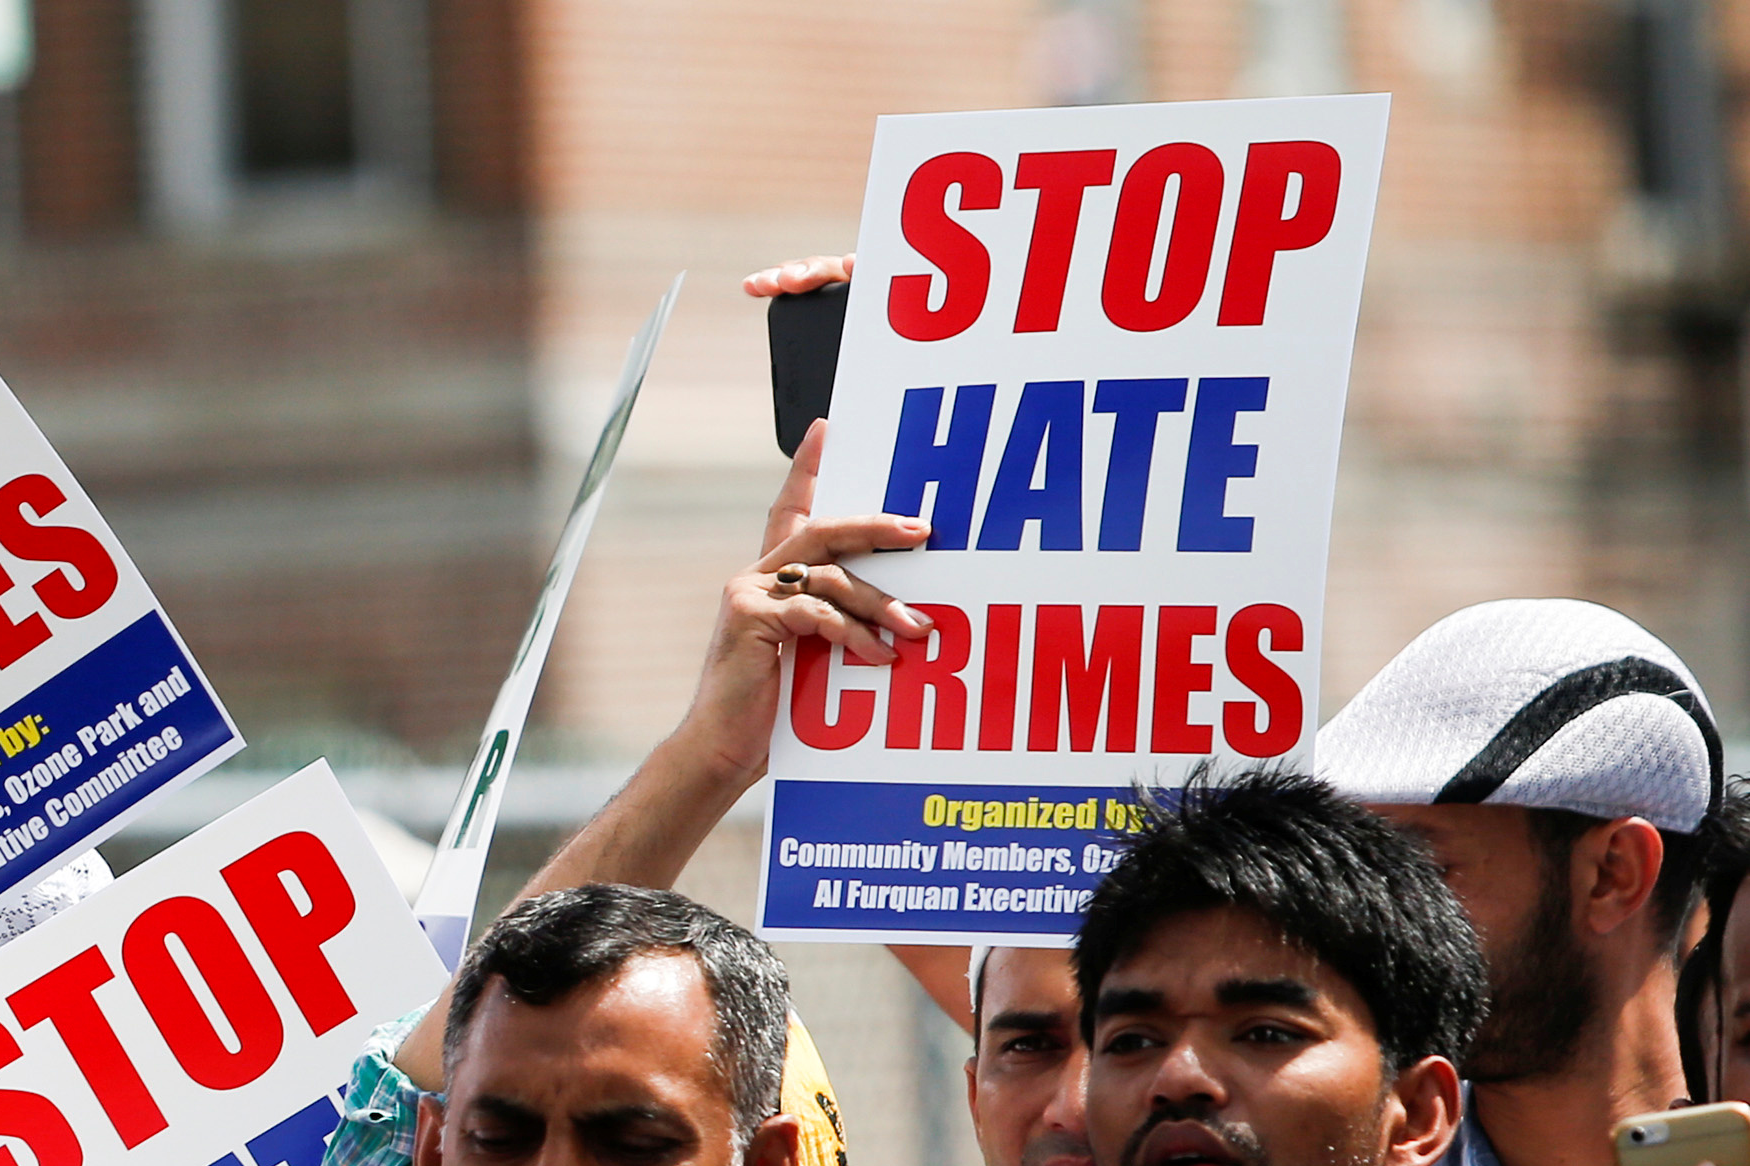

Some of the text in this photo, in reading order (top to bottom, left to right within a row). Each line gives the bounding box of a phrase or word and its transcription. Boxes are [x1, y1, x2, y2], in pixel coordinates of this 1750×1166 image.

[889, 141, 1341, 341] STOP
[873, 376, 1270, 552] HATE
[5, 744, 82, 804] Ozone
[77, 703, 143, 756] Park
[139, 666, 191, 716] and
[790, 602, 1304, 758] CRIMES
[46, 722, 184, 828] Committee
[923, 794, 1097, 831] Organized
[779, 838, 937, 872] Community
[941, 841, 1077, 876] Members,
[813, 880, 843, 908] Al
[846, 880, 959, 911] Furquan
